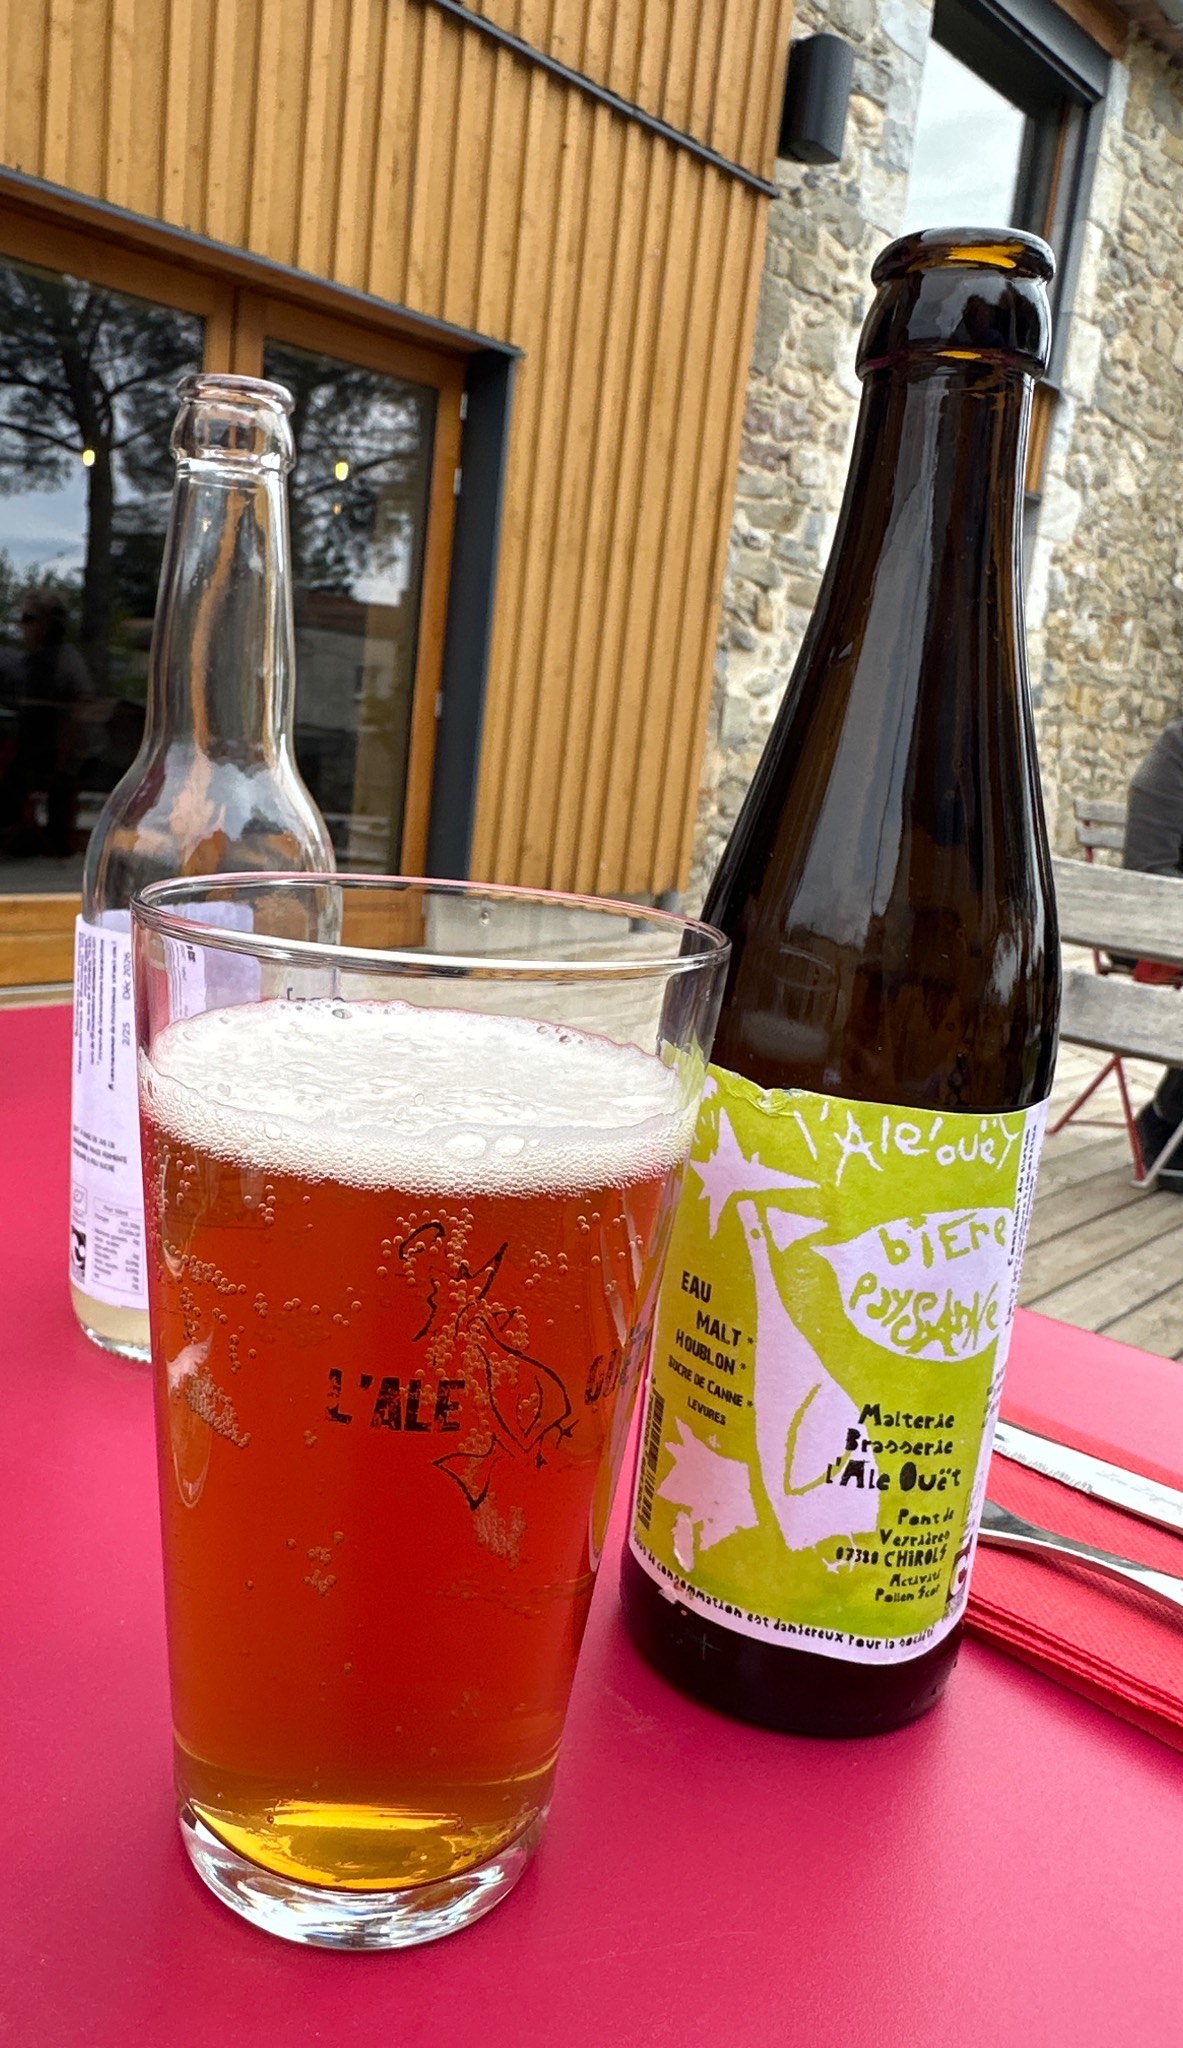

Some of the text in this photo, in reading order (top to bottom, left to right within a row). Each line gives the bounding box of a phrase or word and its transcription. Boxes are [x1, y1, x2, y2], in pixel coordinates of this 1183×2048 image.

[681, 1270, 712, 1303] EAU
[696, 1310, 742, 1347] MALT
[675, 1328, 736, 1375] HOUBLON
[668, 1354, 744, 1407] SUCRE DE CANNE
[326, 1367, 466, 1433] L'ALE
[687, 1395, 727, 1427] LEVURES
[858, 1403, 955, 1429] Malterie
[845, 1427, 954, 1456] Brasserie
[899, 1461, 961, 1492] Ouët
[897, 1508, 940, 1526] Pont
[835, 1546, 880, 1566] 07380
[875, 1587, 915, 1603] Pollen
[746, 1613, 769, 1629] est
